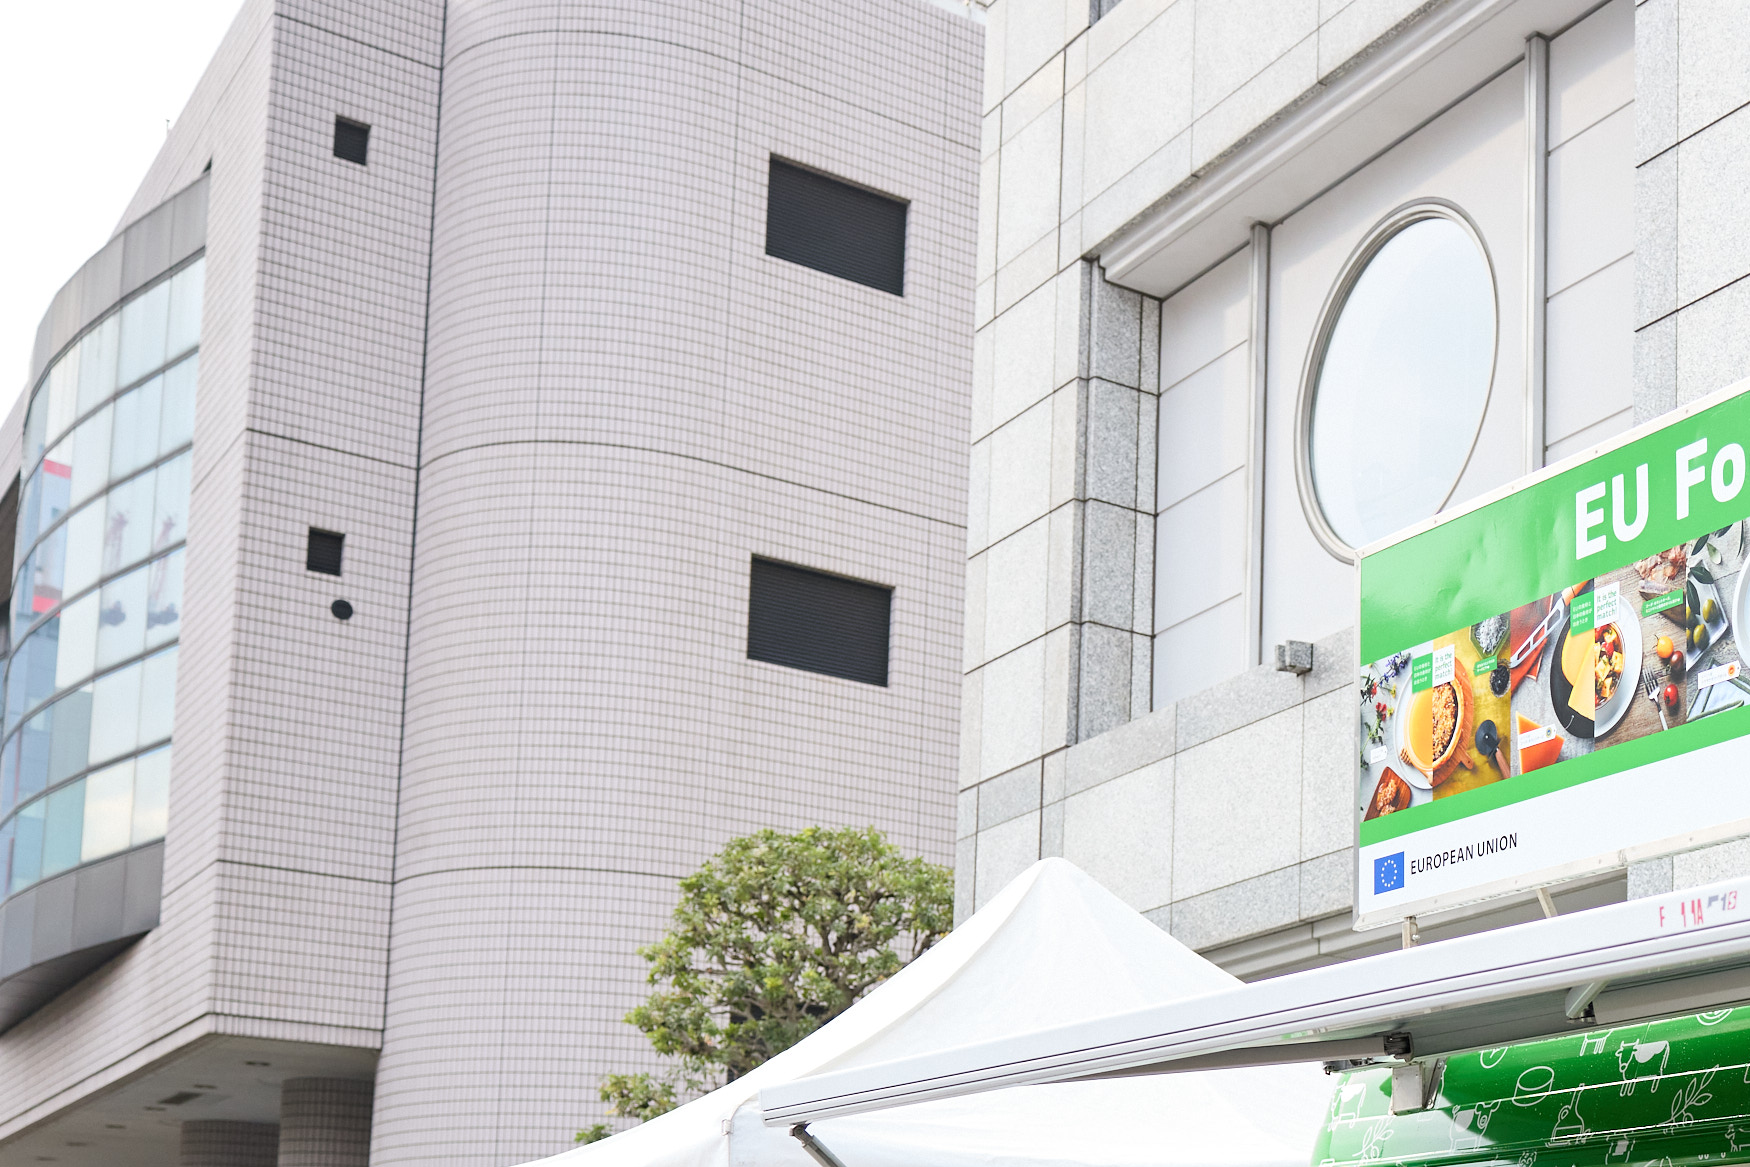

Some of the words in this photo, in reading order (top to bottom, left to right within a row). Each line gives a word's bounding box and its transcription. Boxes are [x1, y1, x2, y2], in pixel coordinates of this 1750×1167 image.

[1575, 463, 1649, 561] EU
[1410, 845, 1474, 875] EUROPEAN
[1477, 832, 1518, 857] UNION
